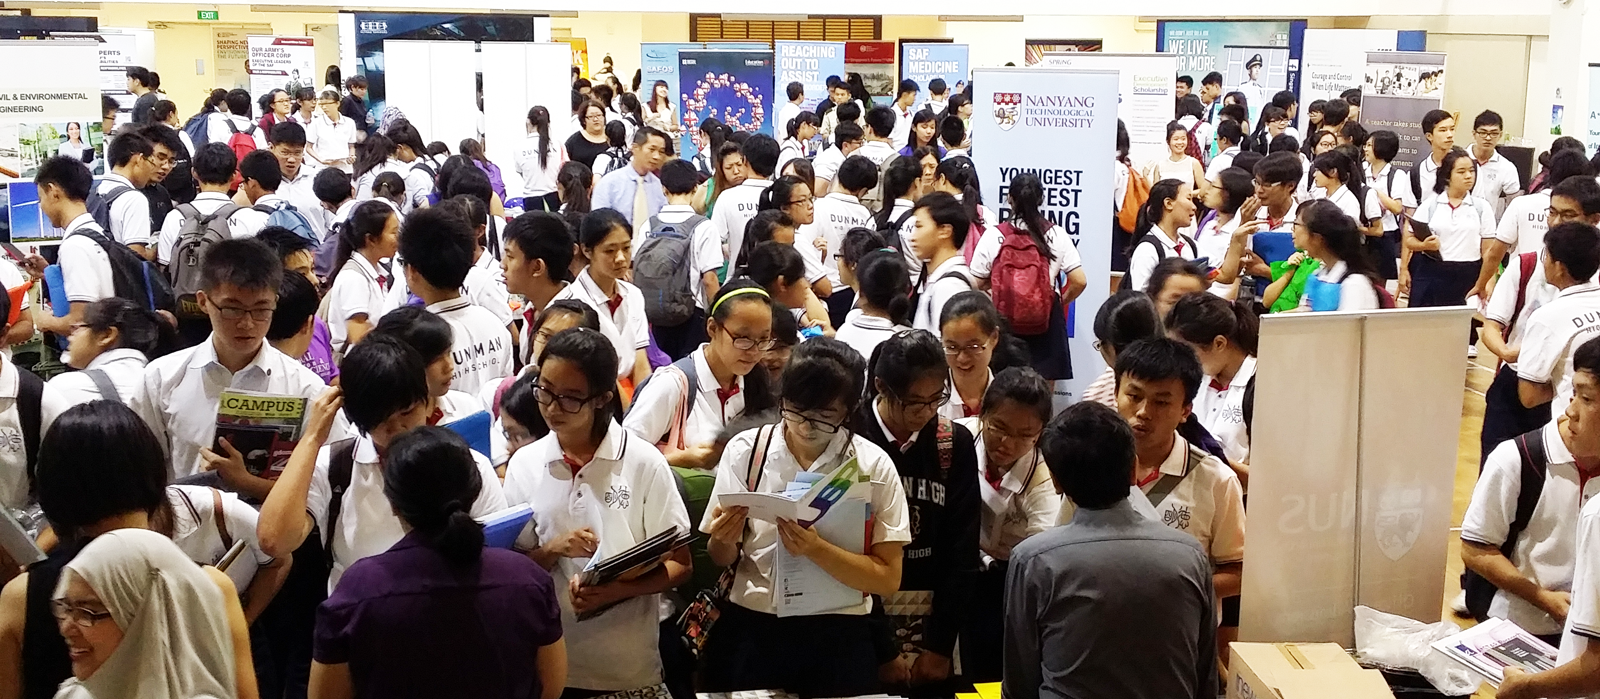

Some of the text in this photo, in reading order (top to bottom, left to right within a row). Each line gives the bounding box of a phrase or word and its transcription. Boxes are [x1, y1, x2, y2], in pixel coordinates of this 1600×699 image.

[781, 45, 836, 58] REACHING
[1169, 40, 1208, 54] WE LIVE
[908, 48, 930, 60] SAF
[646, 65, 674, 73] SAFOS
[781, 58, 819, 70] OUT TO
[909, 62, 958, 73] MEDICINE
[1176, 56, 1216, 71] OR MORE
[780, 71, 820, 82] ASSIST
[1026, 95, 1094, 108] NANYANG
[1026, 108, 1094, 117] TECHNOLOGICAL
[1026, 117, 1094, 128] UNIVERSITY
[999, 167, 1083, 186] YONGEST
[999, 186, 1082, 208] FEST
[830, 214, 867, 226] DUNMA
[452, 336, 502, 365] UNMAN
[226, 398, 295, 412] CAMPUS
